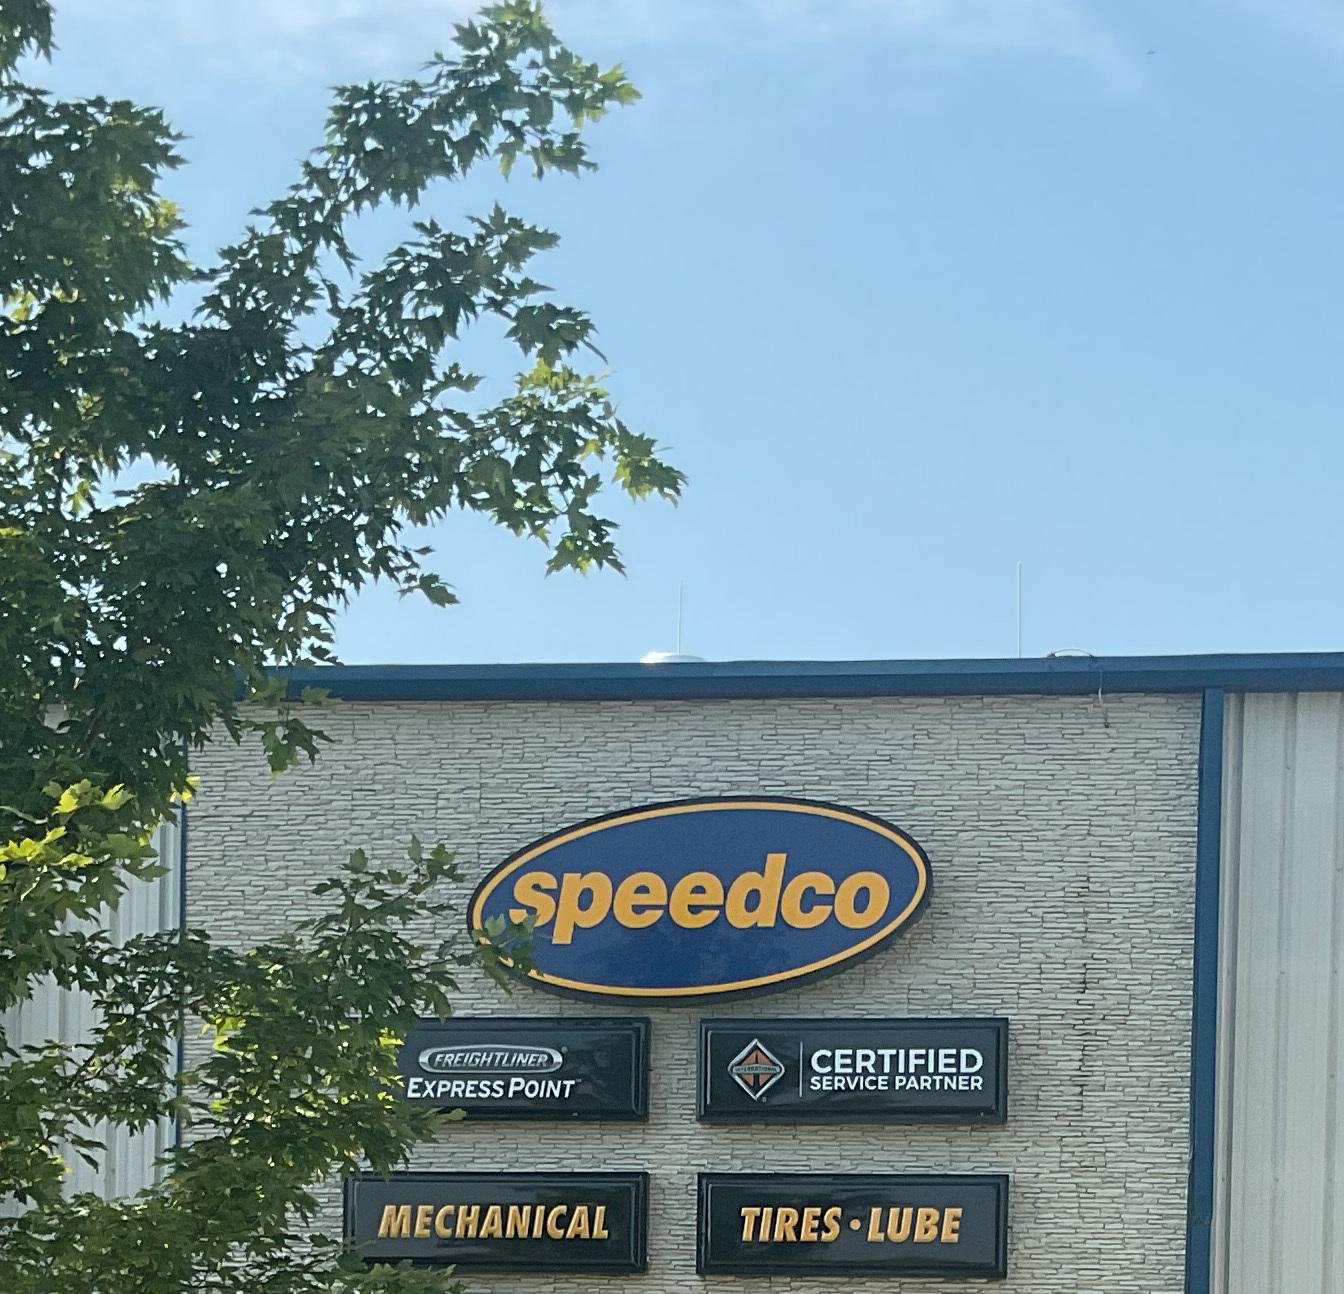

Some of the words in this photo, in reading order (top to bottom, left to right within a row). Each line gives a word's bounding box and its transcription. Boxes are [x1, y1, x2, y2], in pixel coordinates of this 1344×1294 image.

[508, 853, 891, 944] speedco
[433, 1052, 549, 1068] FREIGHTLINER
[811, 1049, 983, 1073] CERTIFIED
[406, 1077, 505, 1098] EXPRESS
[508, 1077, 575, 1098] POINT
[810, 1075, 889, 1090] SERVICE
[895, 1075, 983, 1090] PARTNER
[377, 1205, 609, 1240] MECHANICAL
[740, 1207, 842, 1242] TIRES
[867, 1207, 963, 1242] LUBE
